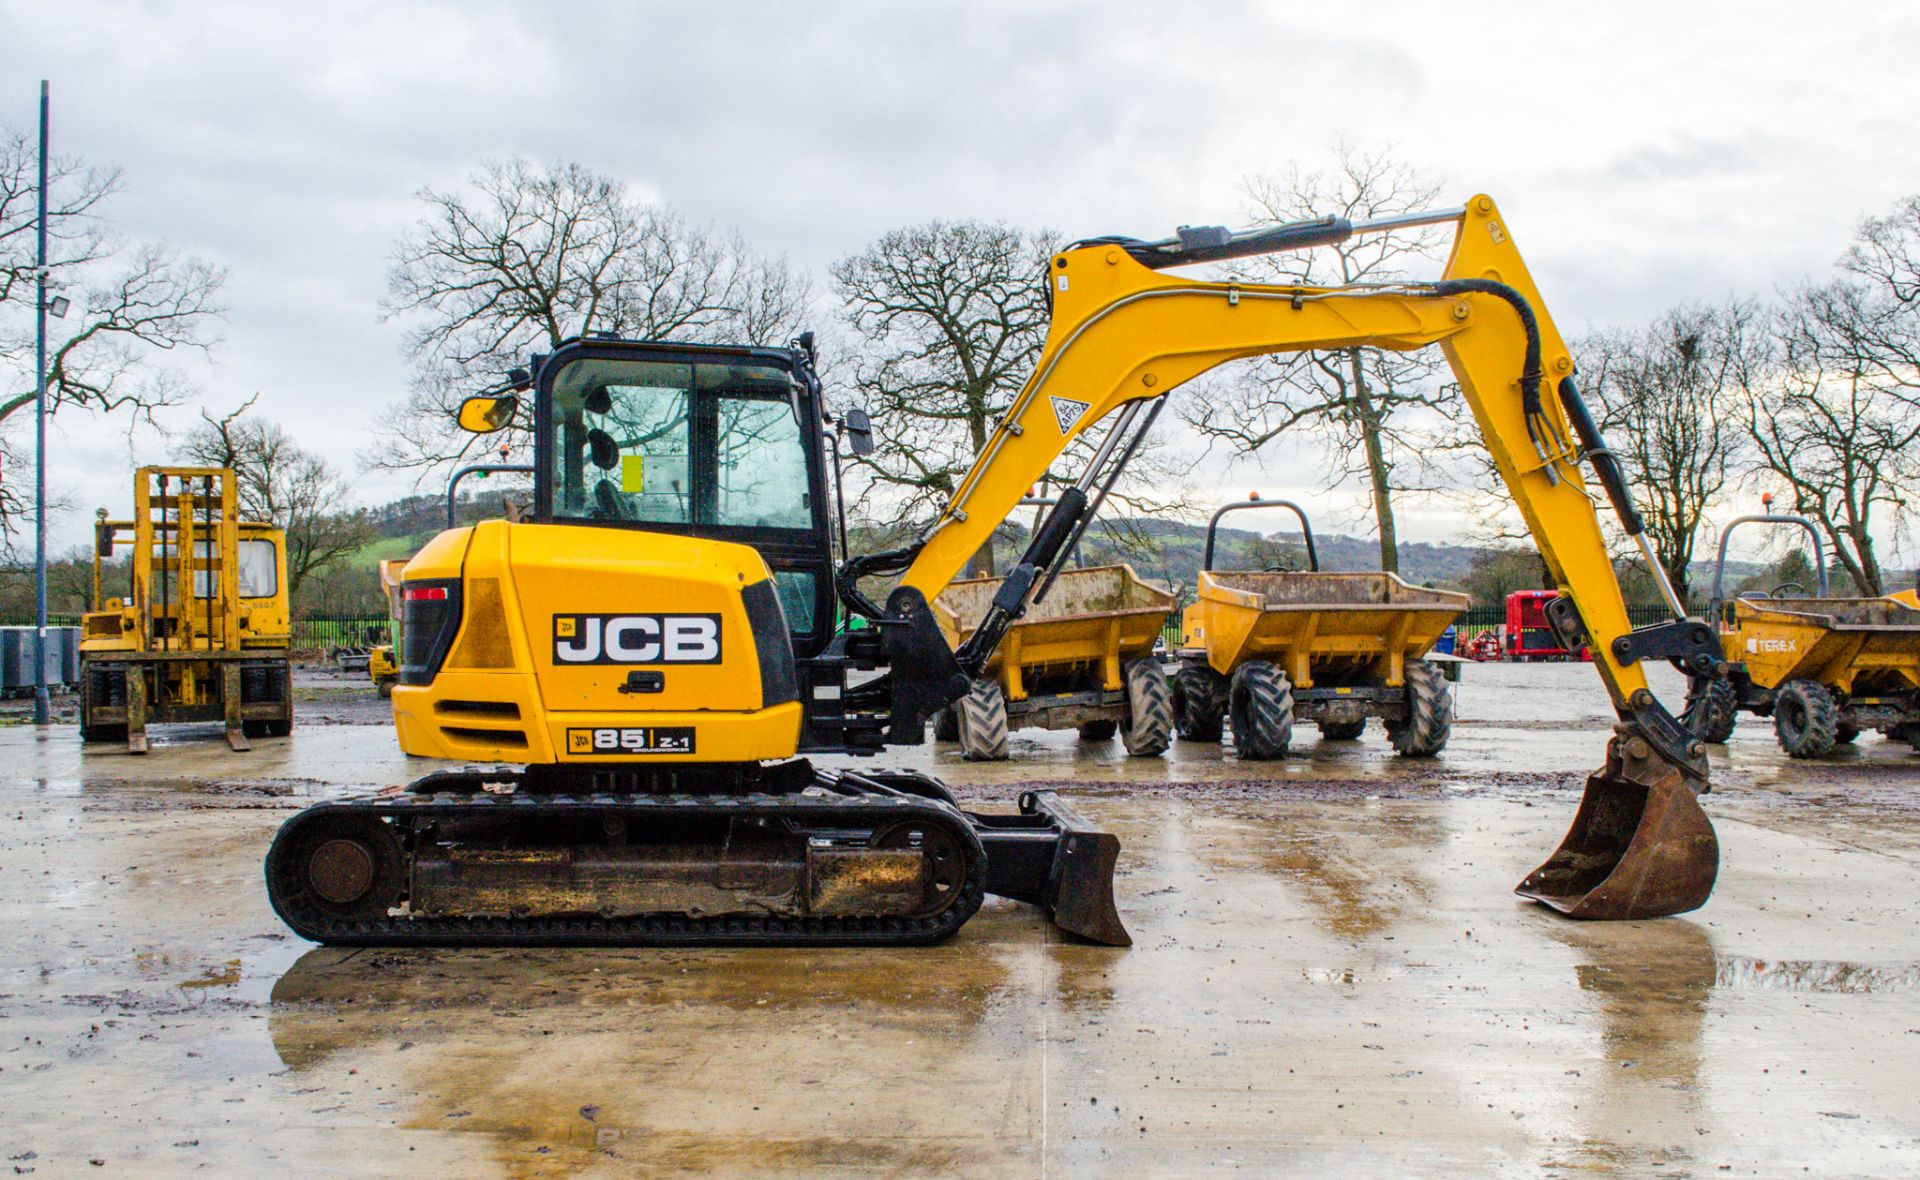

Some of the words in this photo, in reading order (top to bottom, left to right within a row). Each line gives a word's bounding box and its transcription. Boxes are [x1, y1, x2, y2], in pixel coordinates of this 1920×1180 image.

[557, 617, 718, 662] JCB
[1758, 639, 1797, 652] TEREX
[594, 729, 645, 749] 85
[660, 737, 689, 748] Z-1
